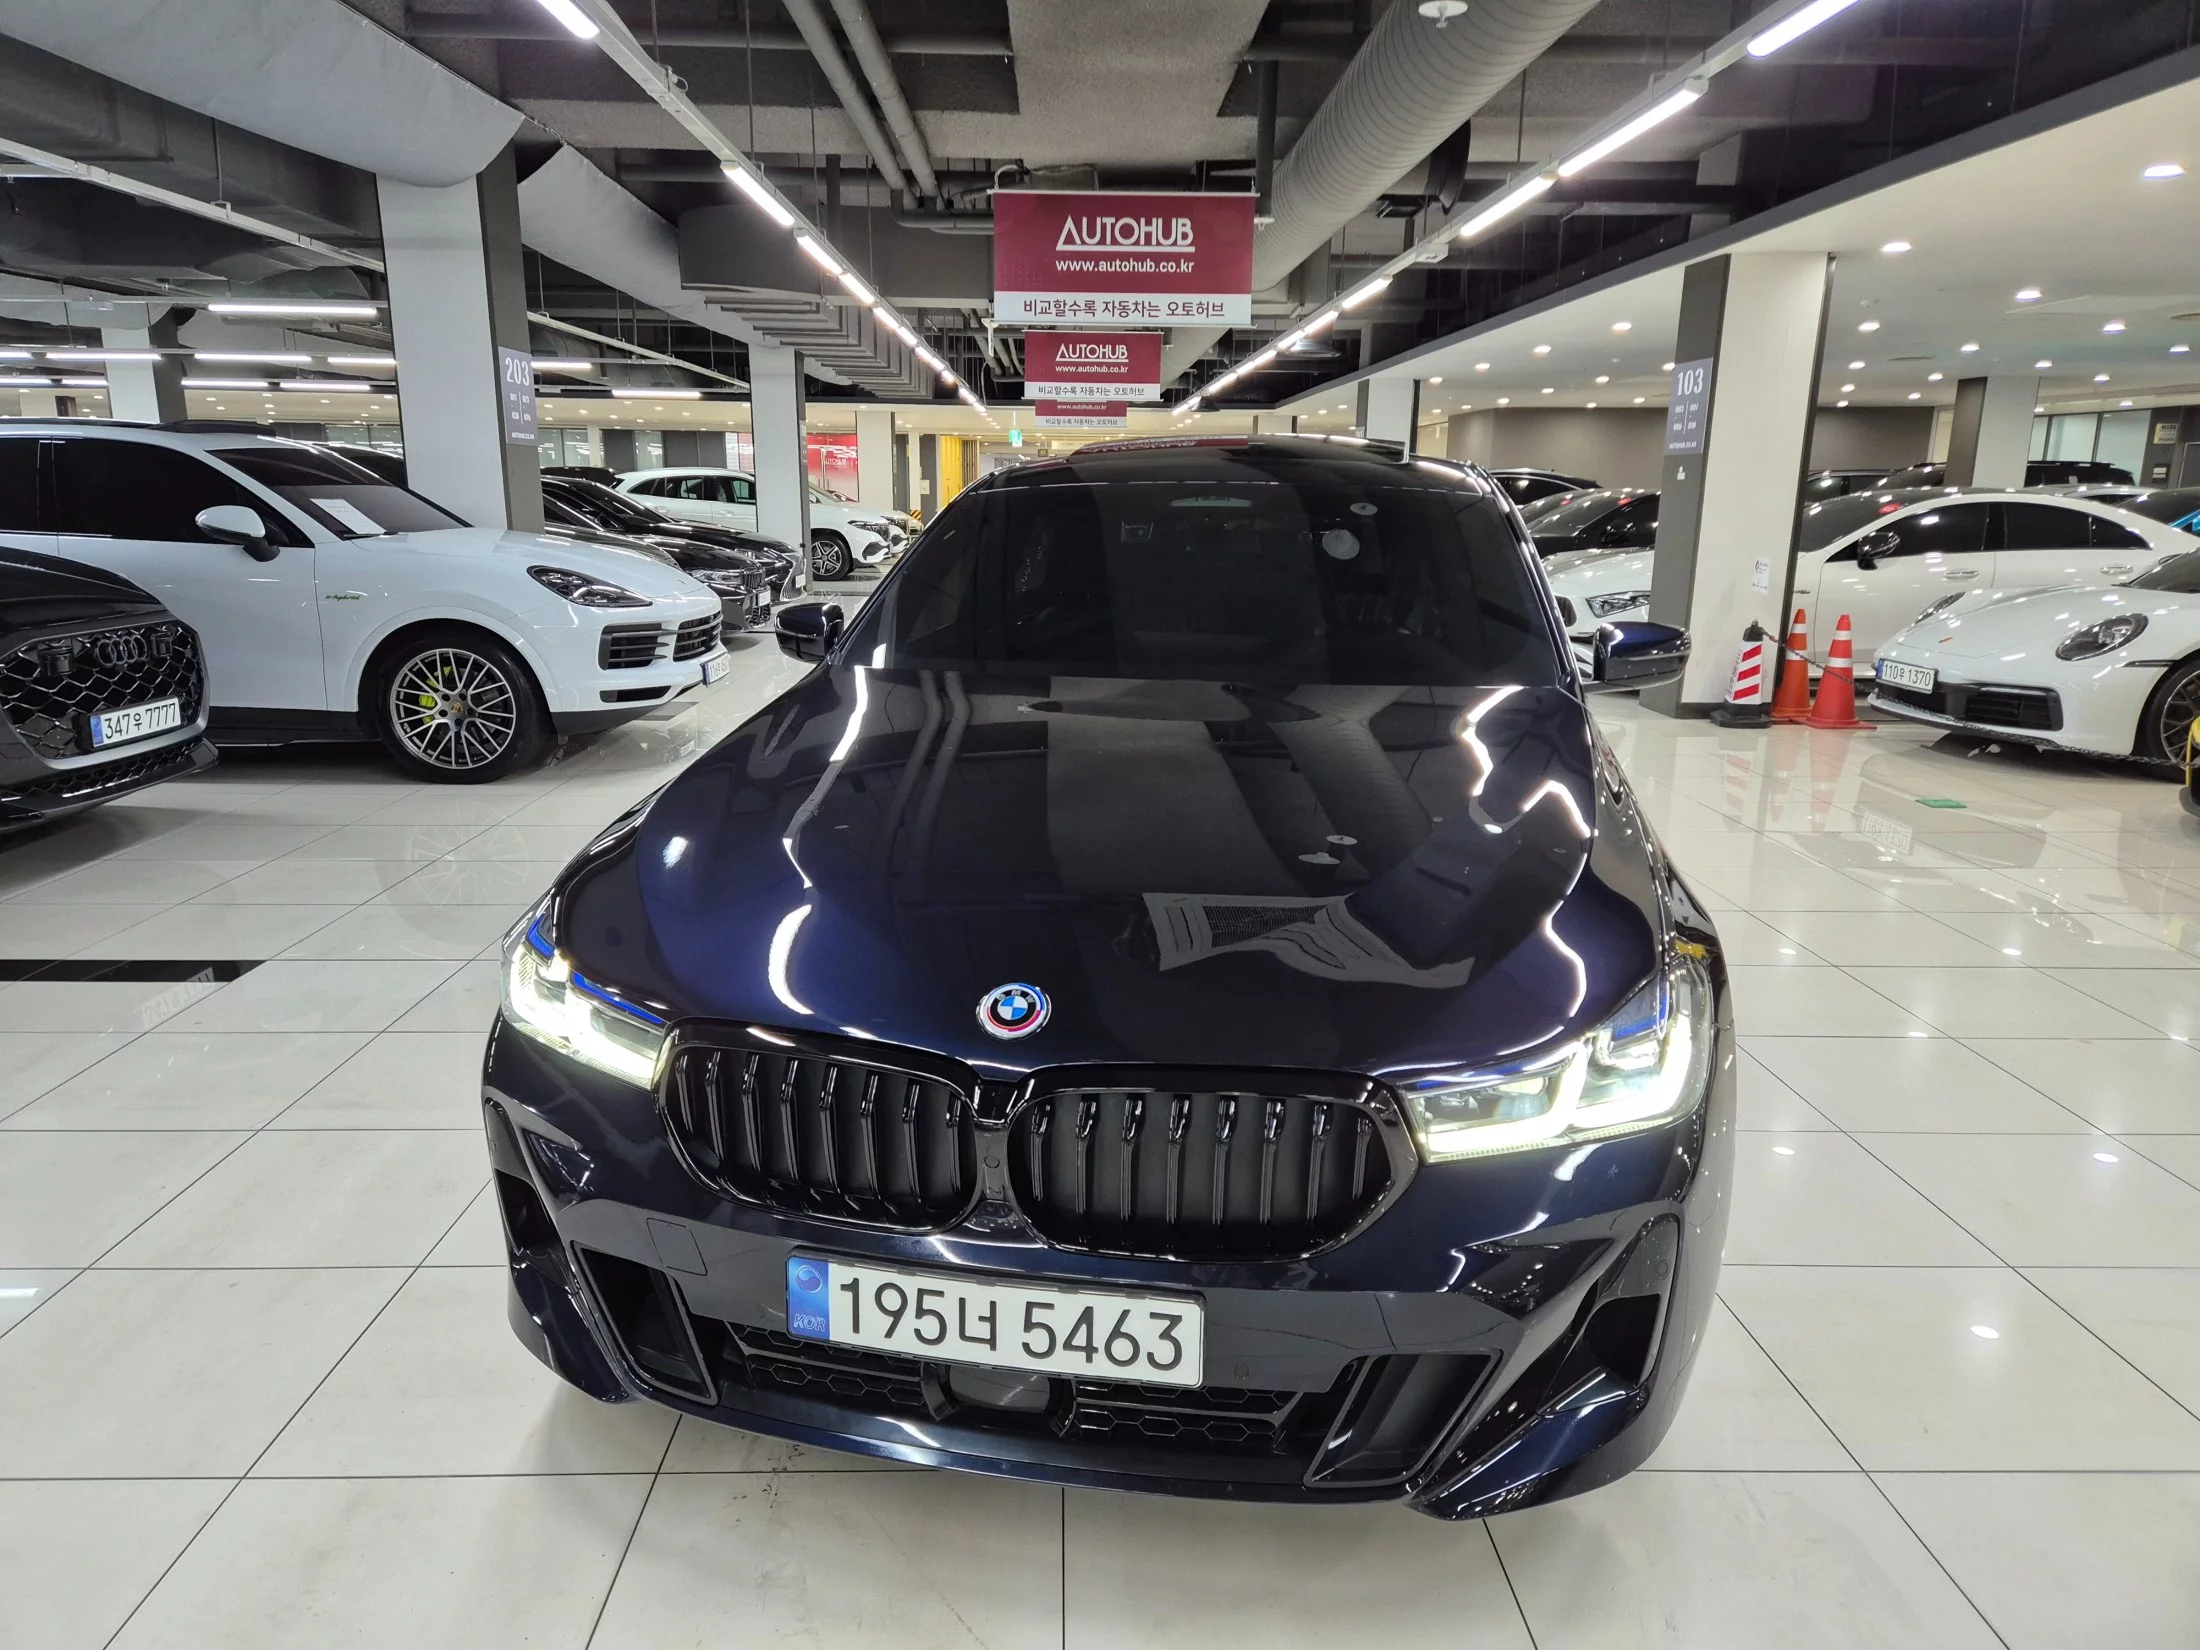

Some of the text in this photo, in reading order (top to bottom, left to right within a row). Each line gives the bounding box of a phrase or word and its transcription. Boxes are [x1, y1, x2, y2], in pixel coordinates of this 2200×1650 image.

[1056, 214, 1196, 253] AUTOHUB
[1055, 258, 1195, 273] www.autohub.co.kr
[1023, 299, 1225, 319] 비교할수록 자동차는 오토허브
[1056, 343, 1129, 363] AUTOHUB
[505, 357, 530, 386] 203
[1055, 364, 1129, 373] www.autohub.co.kr
[1038, 385, 1145, 397] 비교할수록 자동차는 오토허브
[1677, 367, 1704, 396] 103
[1884, 663, 1932, 687] 110우 1370
[104, 702, 177, 740] 347우 7777
[793, 1313, 826, 1332] KOR
[840, 1276, 1184, 1372] 195너 5463
